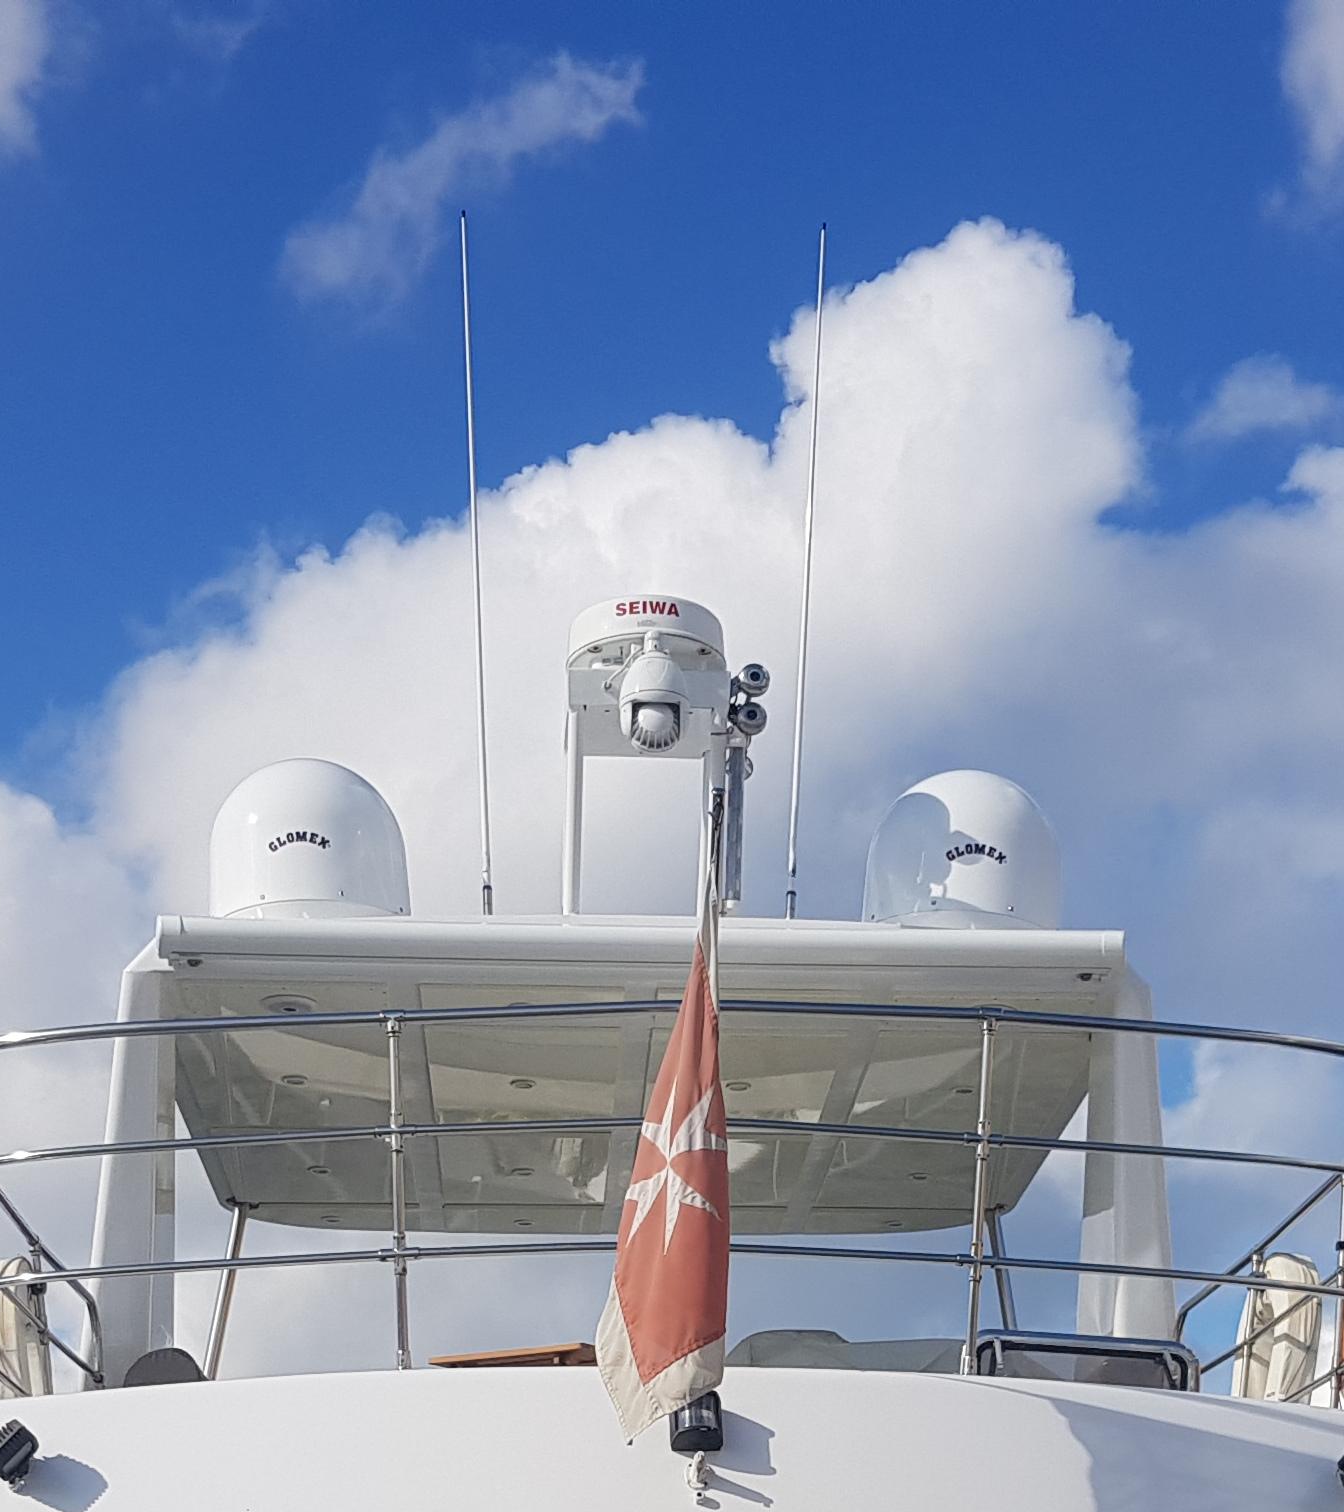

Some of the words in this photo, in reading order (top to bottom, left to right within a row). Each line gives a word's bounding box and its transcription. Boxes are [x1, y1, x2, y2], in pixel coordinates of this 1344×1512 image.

[615, 600, 680, 617] SEIWA
[268, 830, 329, 852] GLOMEX
[945, 842, 1007, 865] GLOMEX
